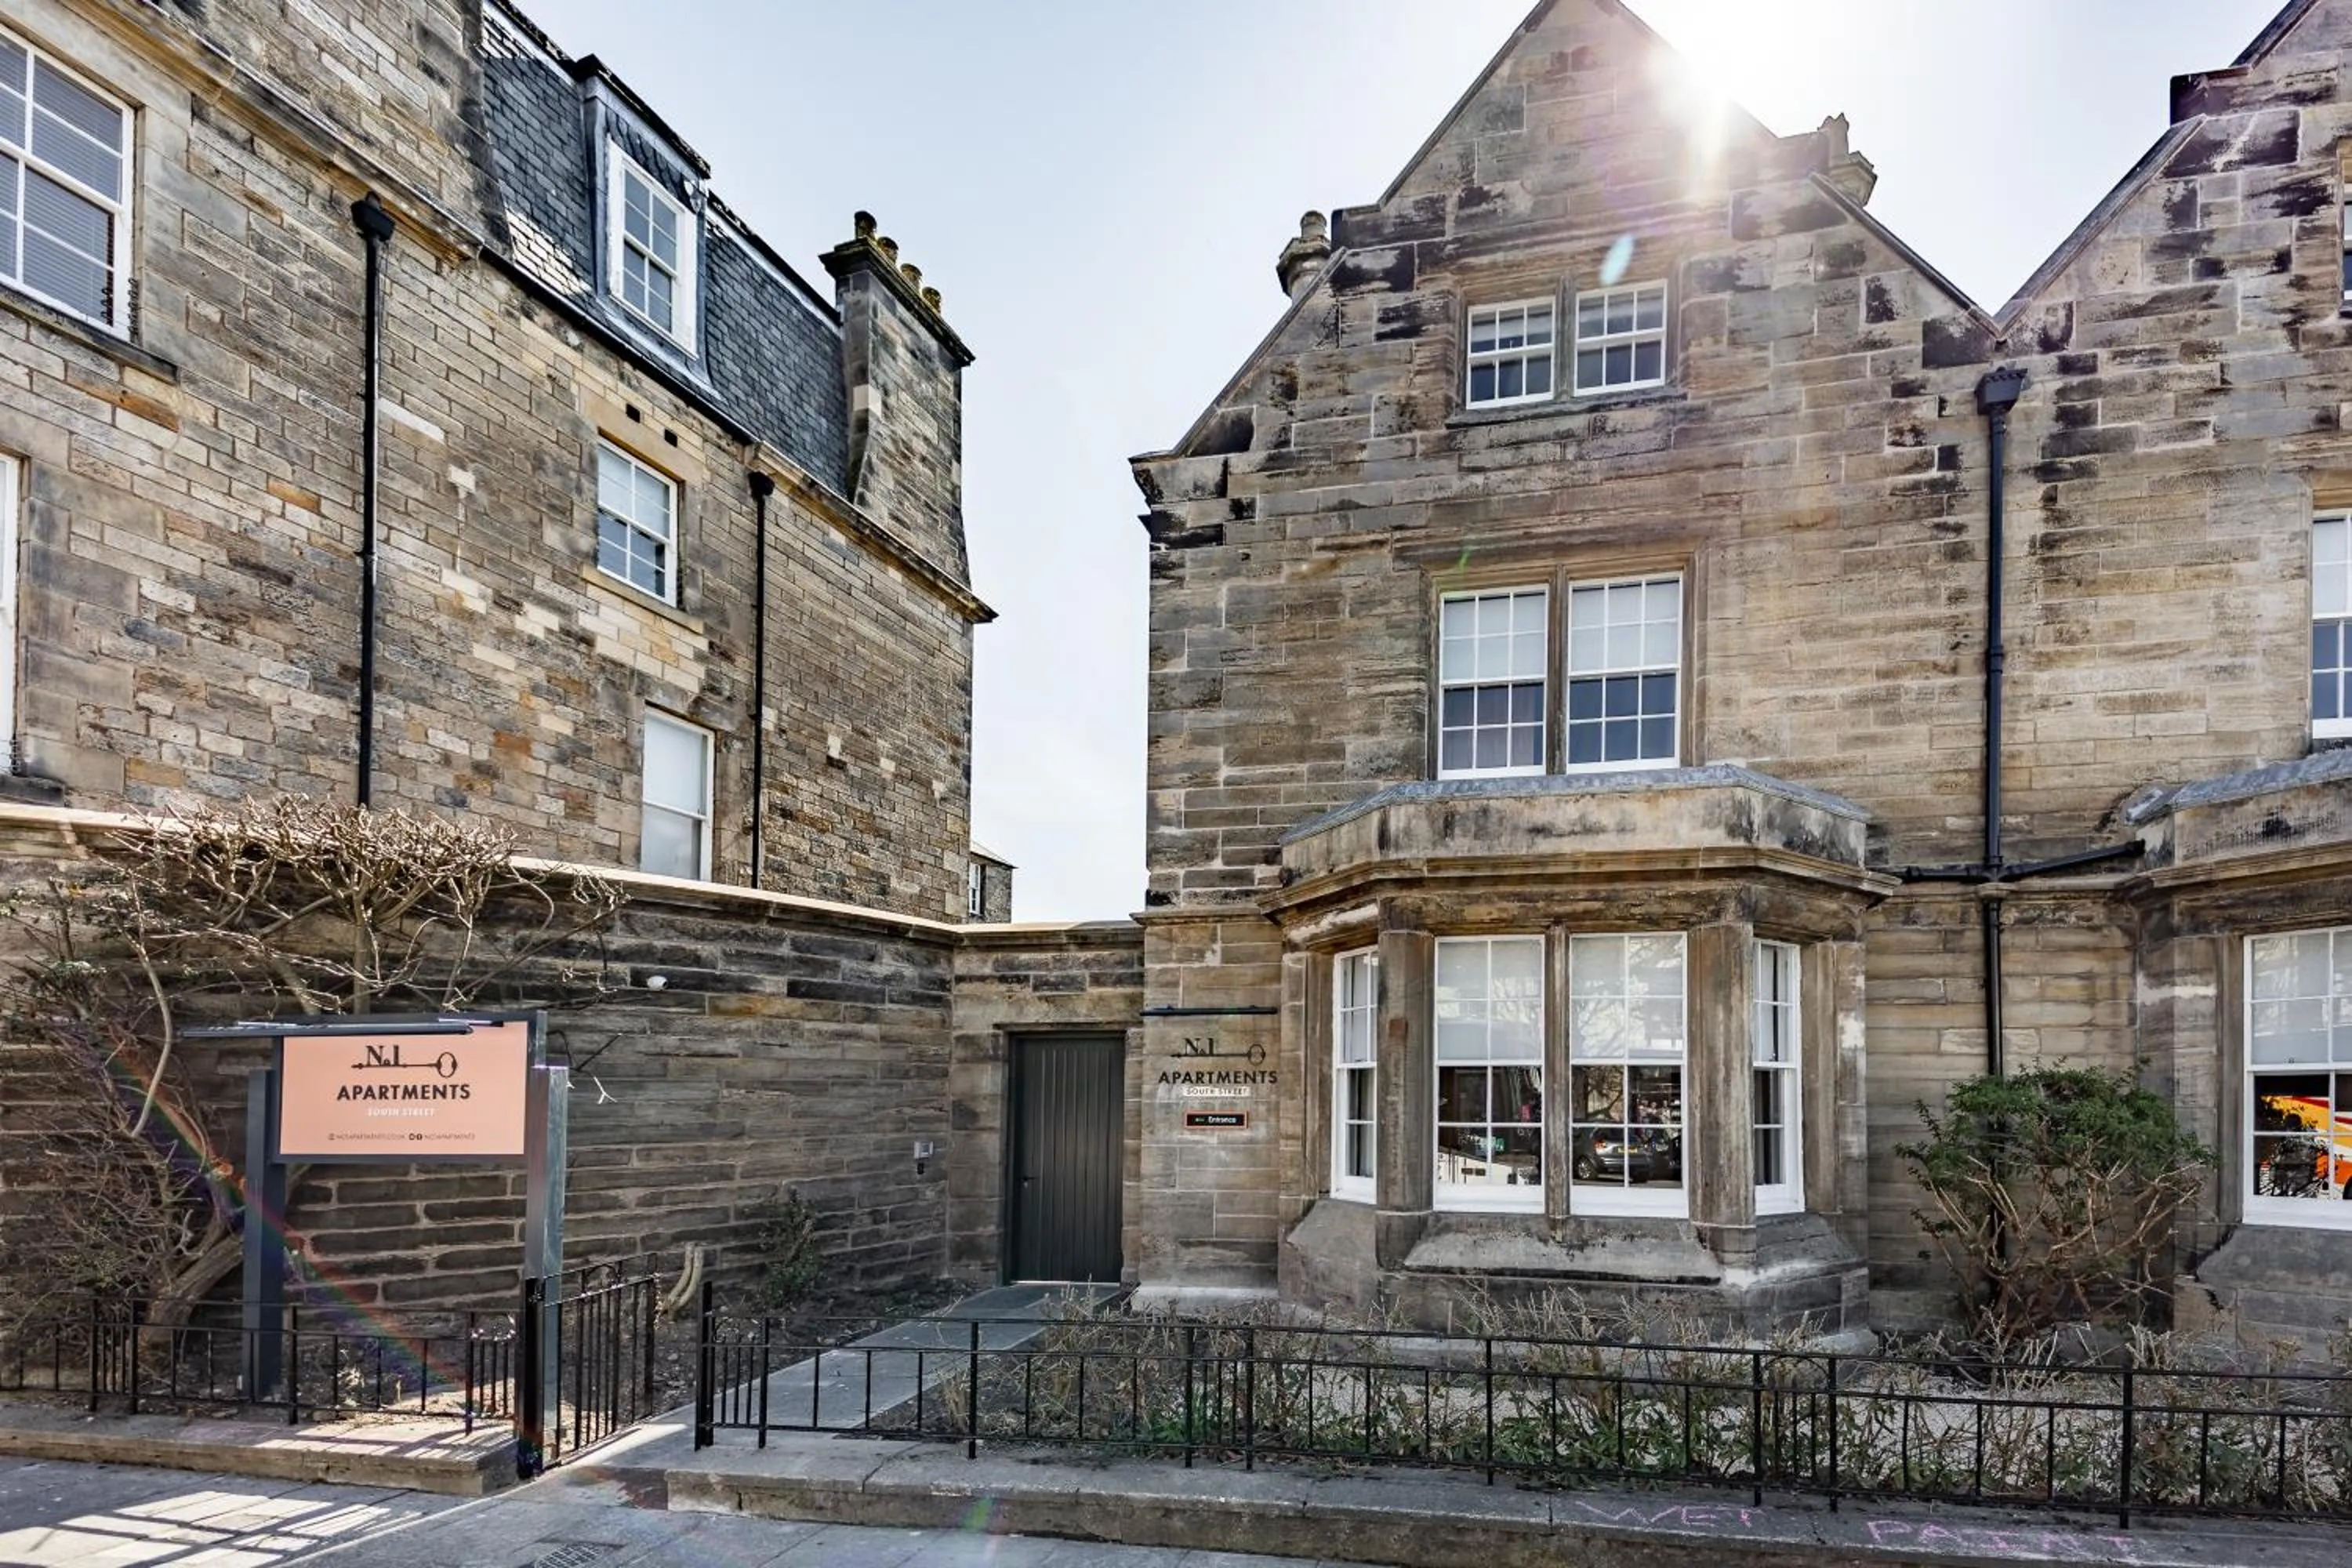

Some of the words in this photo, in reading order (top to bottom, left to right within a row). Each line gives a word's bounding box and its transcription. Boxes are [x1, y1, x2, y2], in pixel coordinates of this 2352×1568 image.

[1158, 1070, 1278, 1083] APARTMENTS
[336, 1083, 471, 1101] APARTMENTS
[1218, 1087, 1247, 1095] STREET
[1575, 1501, 1767, 1528] WET
[1867, 1519, 2134, 1553] PAINT
